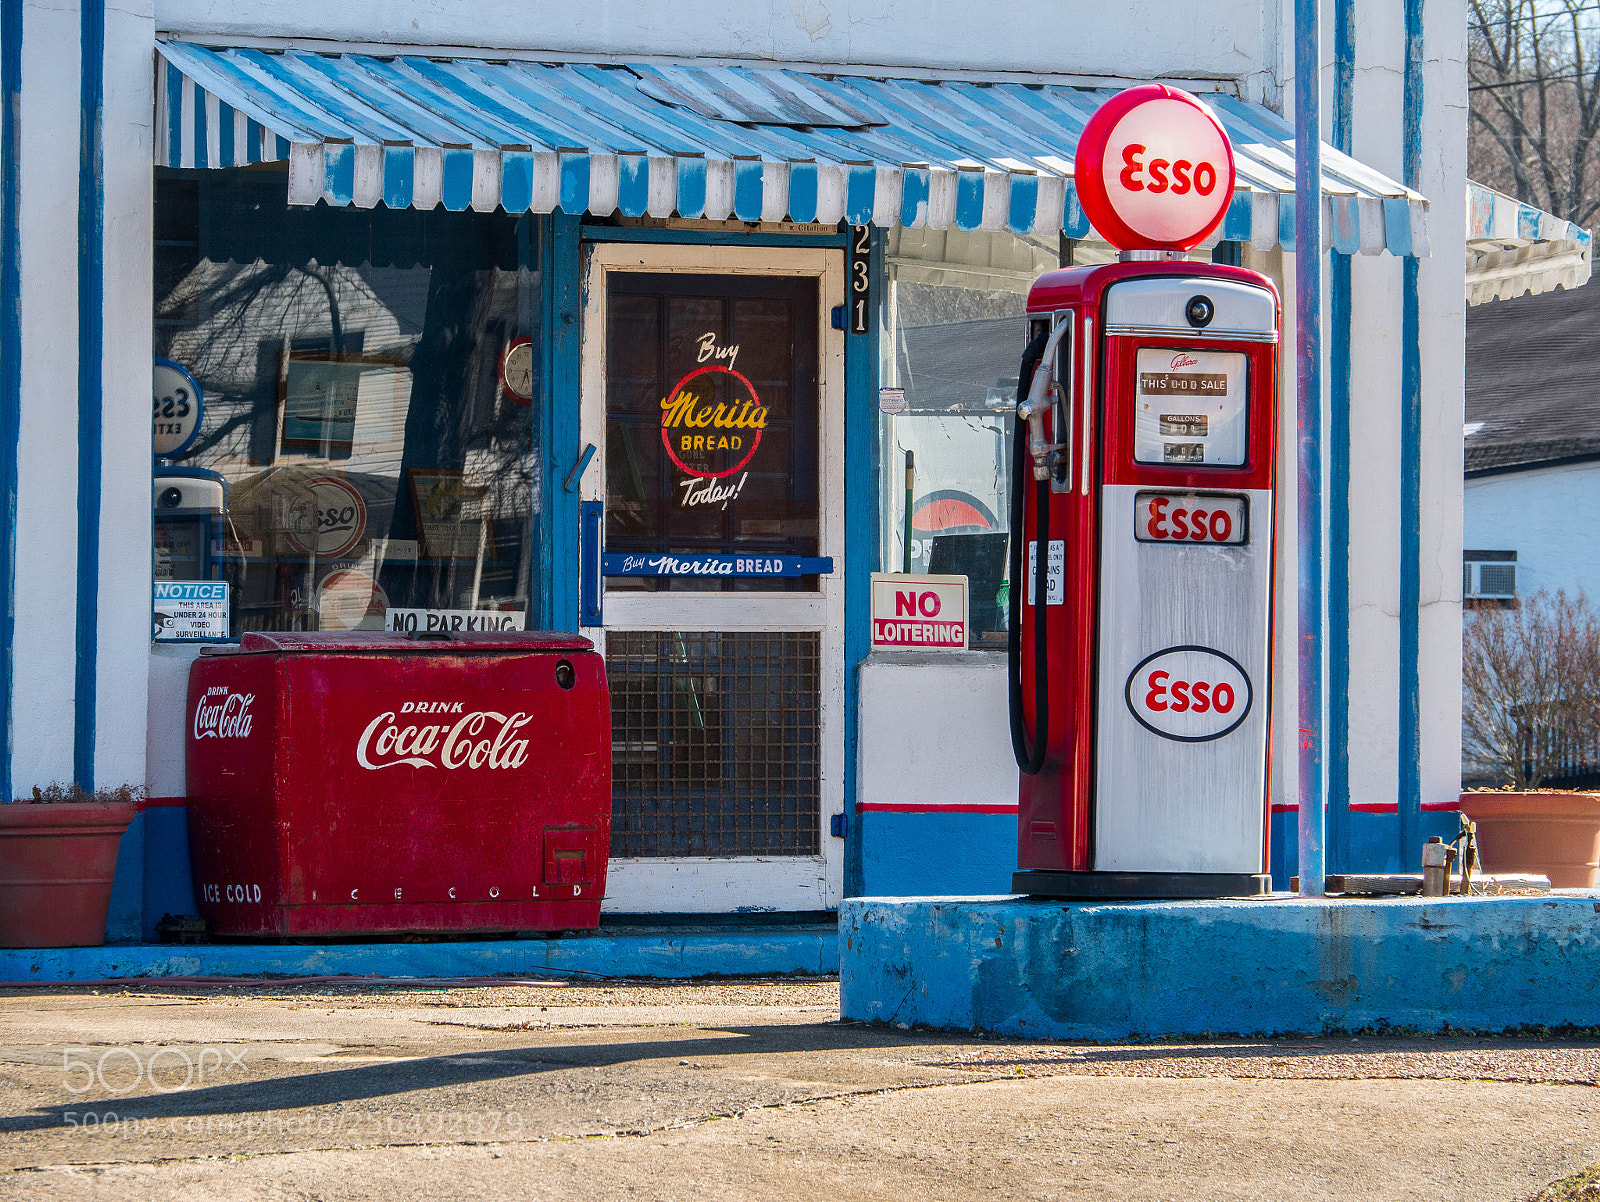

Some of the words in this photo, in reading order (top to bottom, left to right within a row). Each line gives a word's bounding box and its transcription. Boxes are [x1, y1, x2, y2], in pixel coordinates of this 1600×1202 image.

[1120, 143, 1217, 197] Esso
[798, 224, 828, 232] Citation
[854, 225, 871, 331] 231
[695, 332, 740, 371] Buy
[1142, 379, 1167, 389] THIS
[1200, 380, 1226, 390] SALE
[660, 391, 771, 429] Merita
[681, 435, 742, 450] BREAD
[680, 471, 748, 510] Today!
[1147, 497, 1232, 541] Esso
[622, 556, 645, 573] Buy
[648, 556, 733, 574] Merita
[736, 559, 783, 573] BREAD
[155, 585, 224, 598] NOTICE
[178, 601, 194, 609] THIS
[196, 601, 213, 609] AREA
[215, 601, 222, 609] IS
[895, 591, 941, 618] NO
[174, 611, 197, 619] UNDER
[198, 611, 206, 619] 24
[208, 611, 227, 619] HOUR
[190, 621, 211, 629] VIDEO
[392, 612, 418, 631] NO
[426, 613, 517, 631] PARKING
[874, 623, 963, 643] LOITERING
[207, 686, 229, 696] DRINK
[1145, 670, 1235, 714] Esso
[193, 692, 256, 740] Coca-Cola
[400, 701, 465, 714] DRINK
[356, 710, 534, 770] Coca-Cola
[203, 883, 221, 903] ICE
[226, 883, 261, 903] COLD
